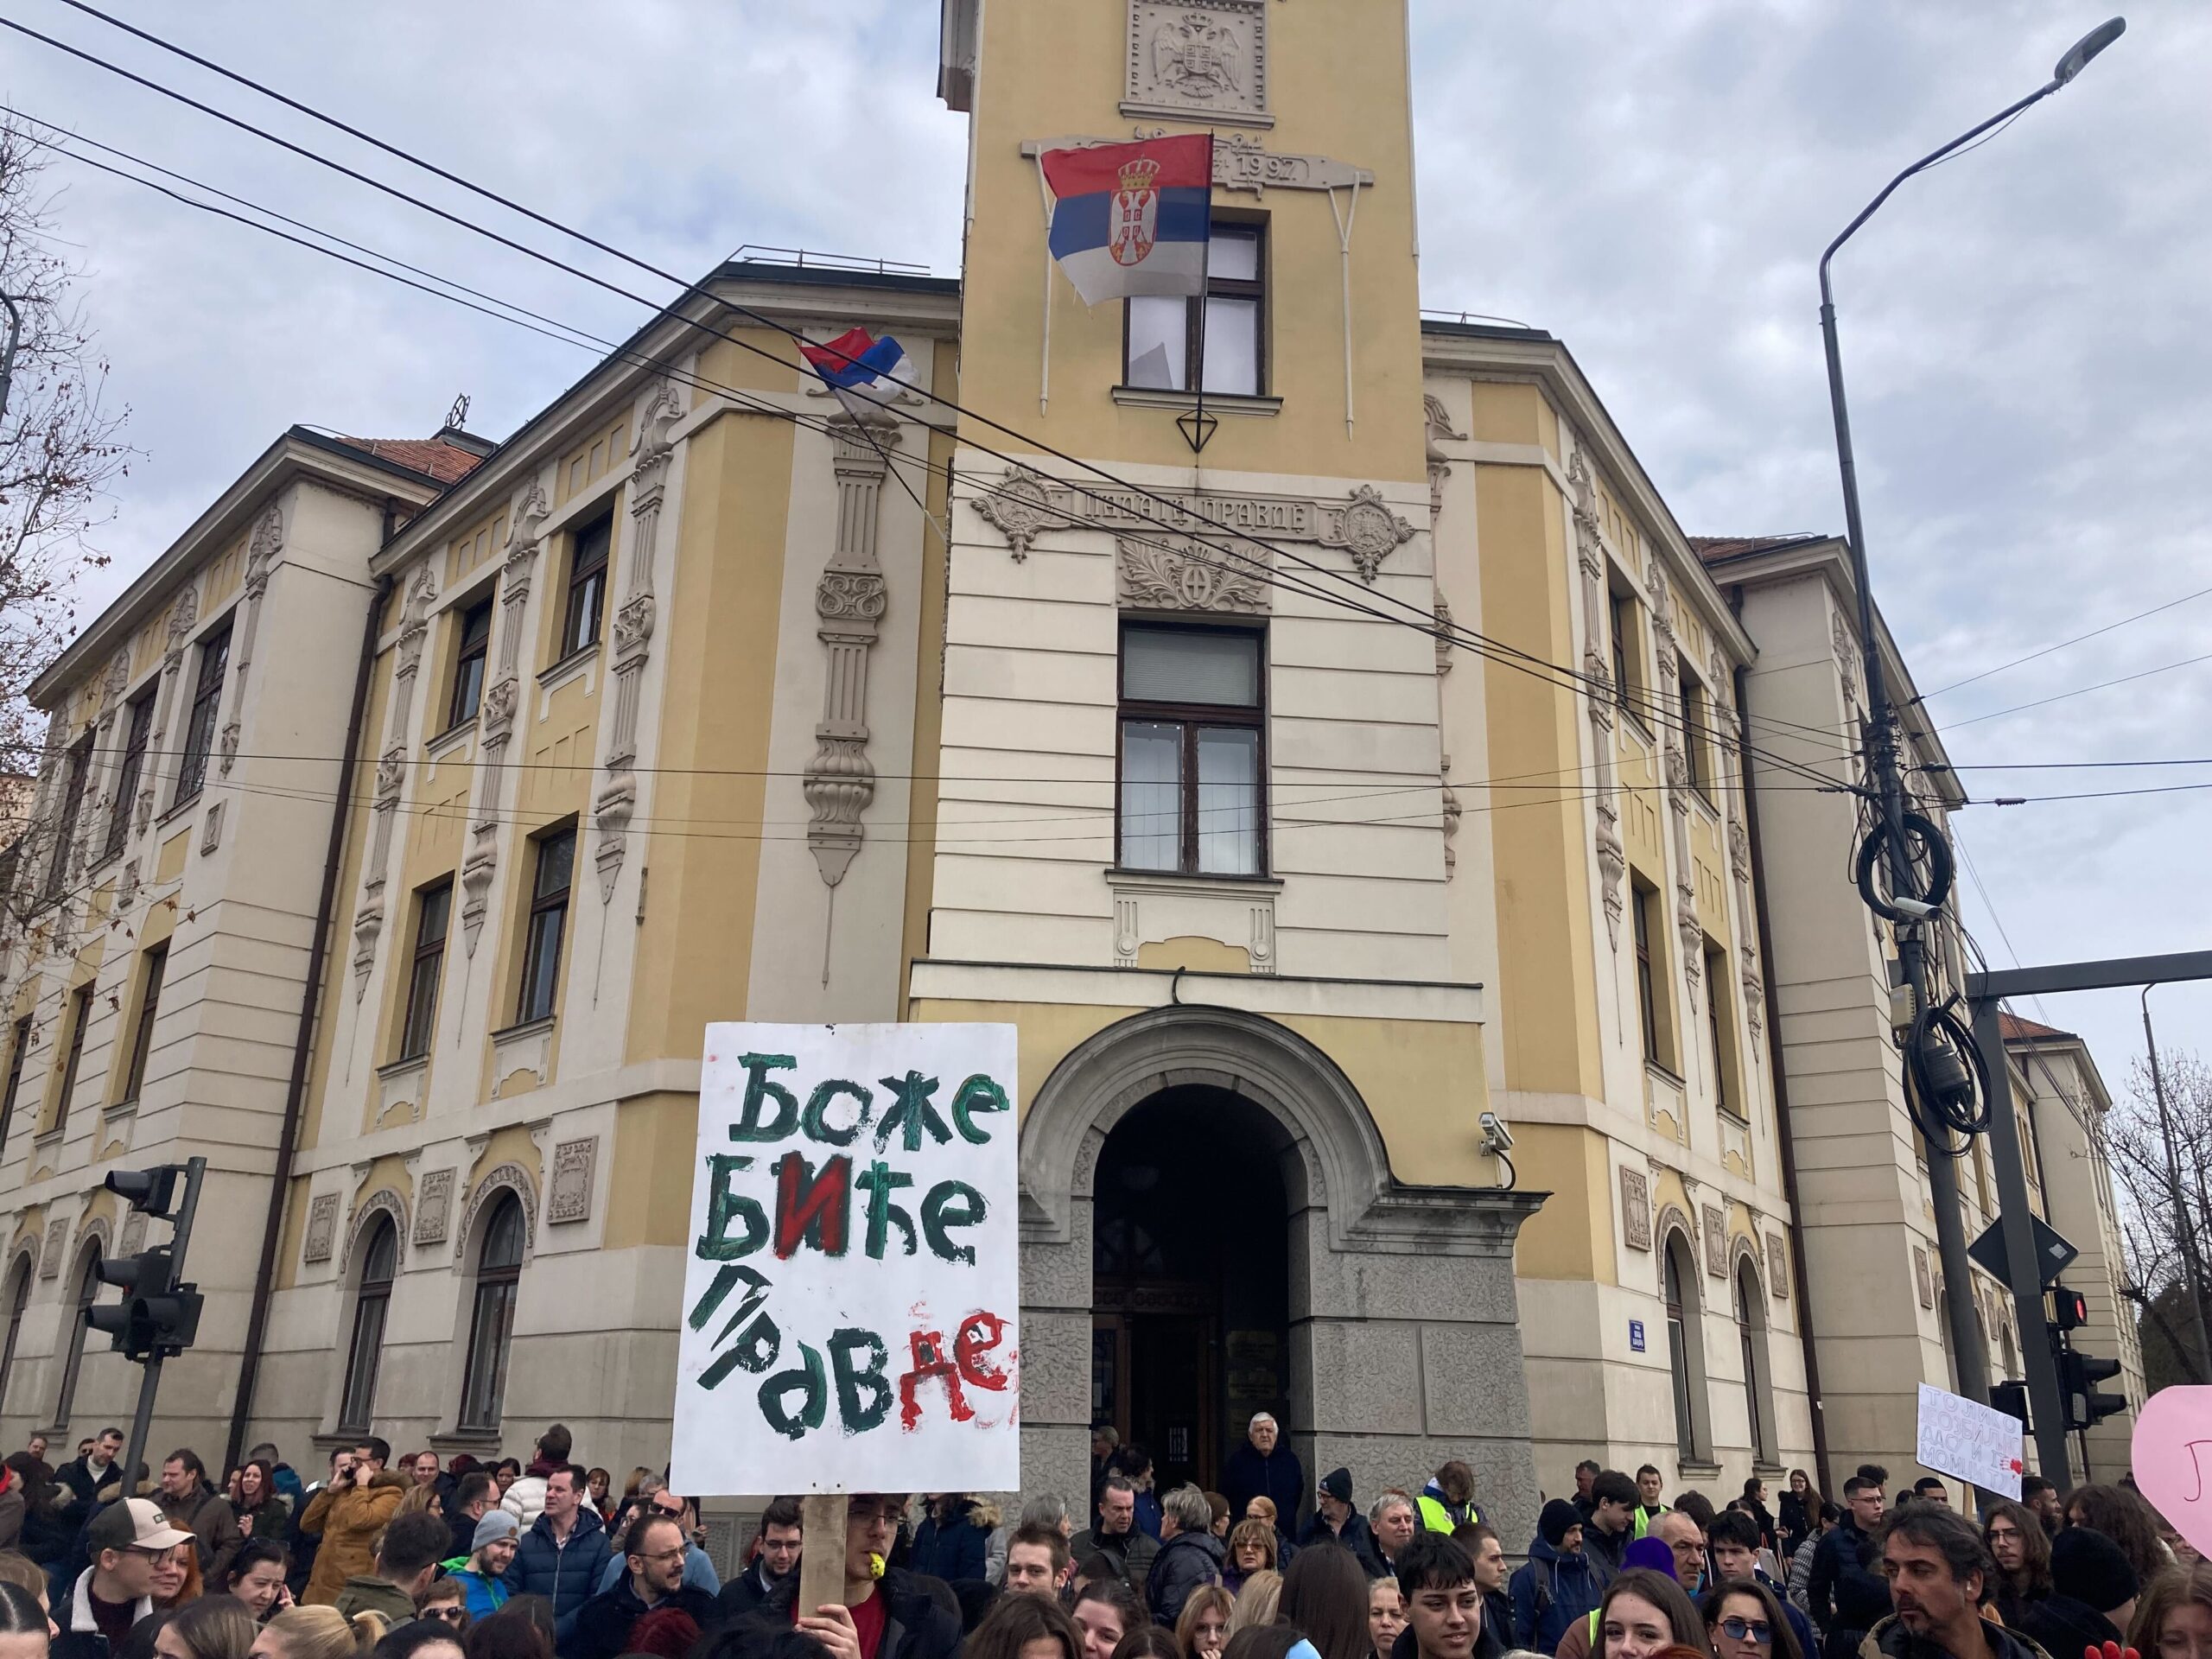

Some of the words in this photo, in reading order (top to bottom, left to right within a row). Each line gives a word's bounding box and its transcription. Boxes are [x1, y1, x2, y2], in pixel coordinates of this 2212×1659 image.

[1202, 498, 1306, 530] ПРАВДЕ
[728, 1051, 1010, 1154] Боже
[1925, 1387, 2018, 1433] ТОЛИКО
[1971, 1441, 1982, 1462] И
